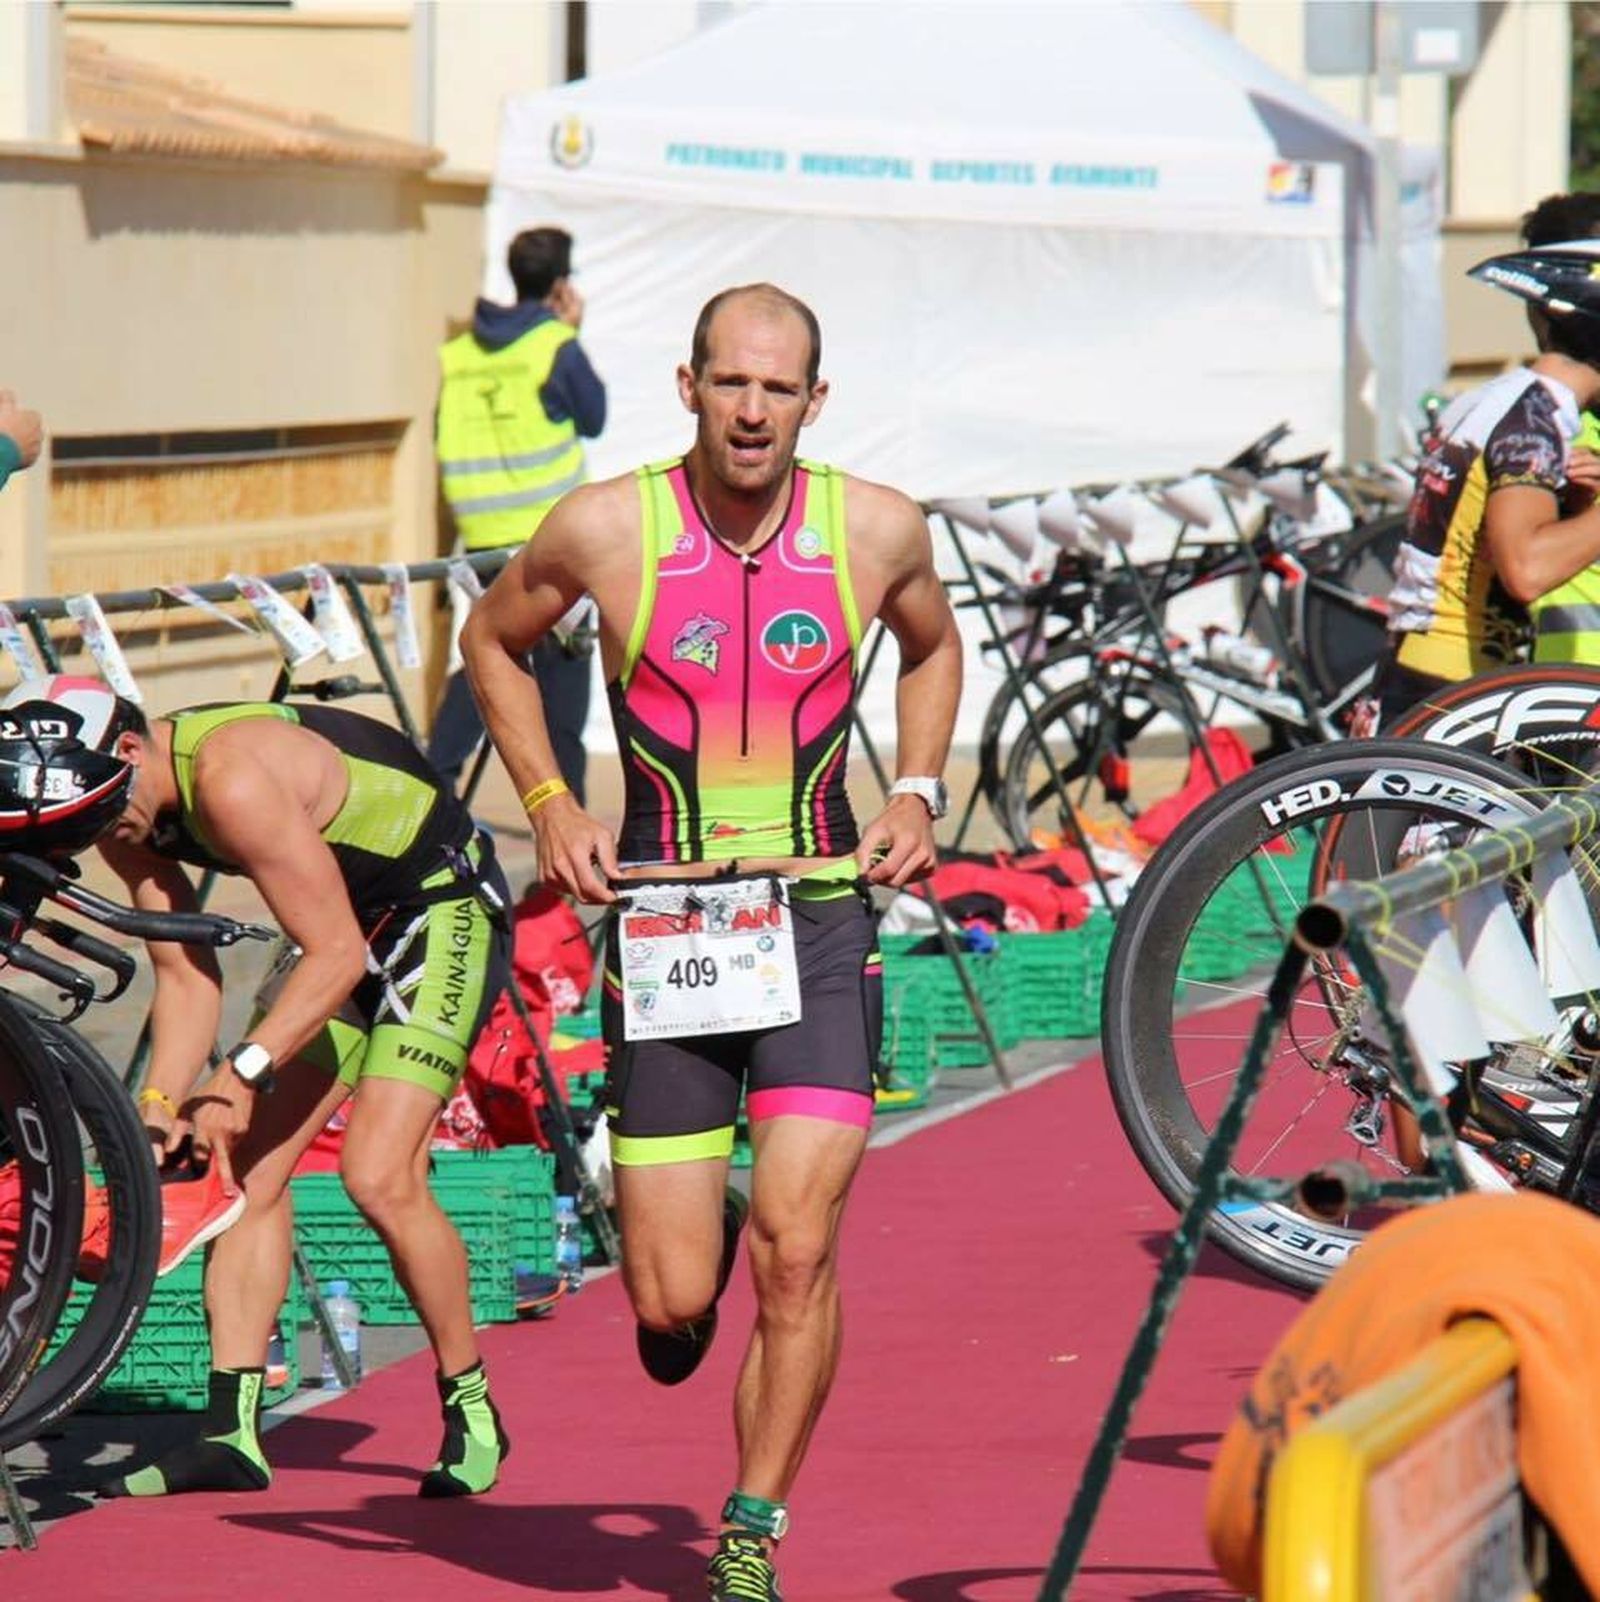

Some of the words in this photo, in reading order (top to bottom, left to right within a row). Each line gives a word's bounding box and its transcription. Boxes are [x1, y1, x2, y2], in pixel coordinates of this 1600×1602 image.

[799, 152, 914, 181] MUNICIPAL
[929, 159, 1035, 186] DEPORTES
[1413, 781, 1507, 816] JET
[667, 956, 718, 989] 409
[1252, 1222, 1345, 1256] JET
